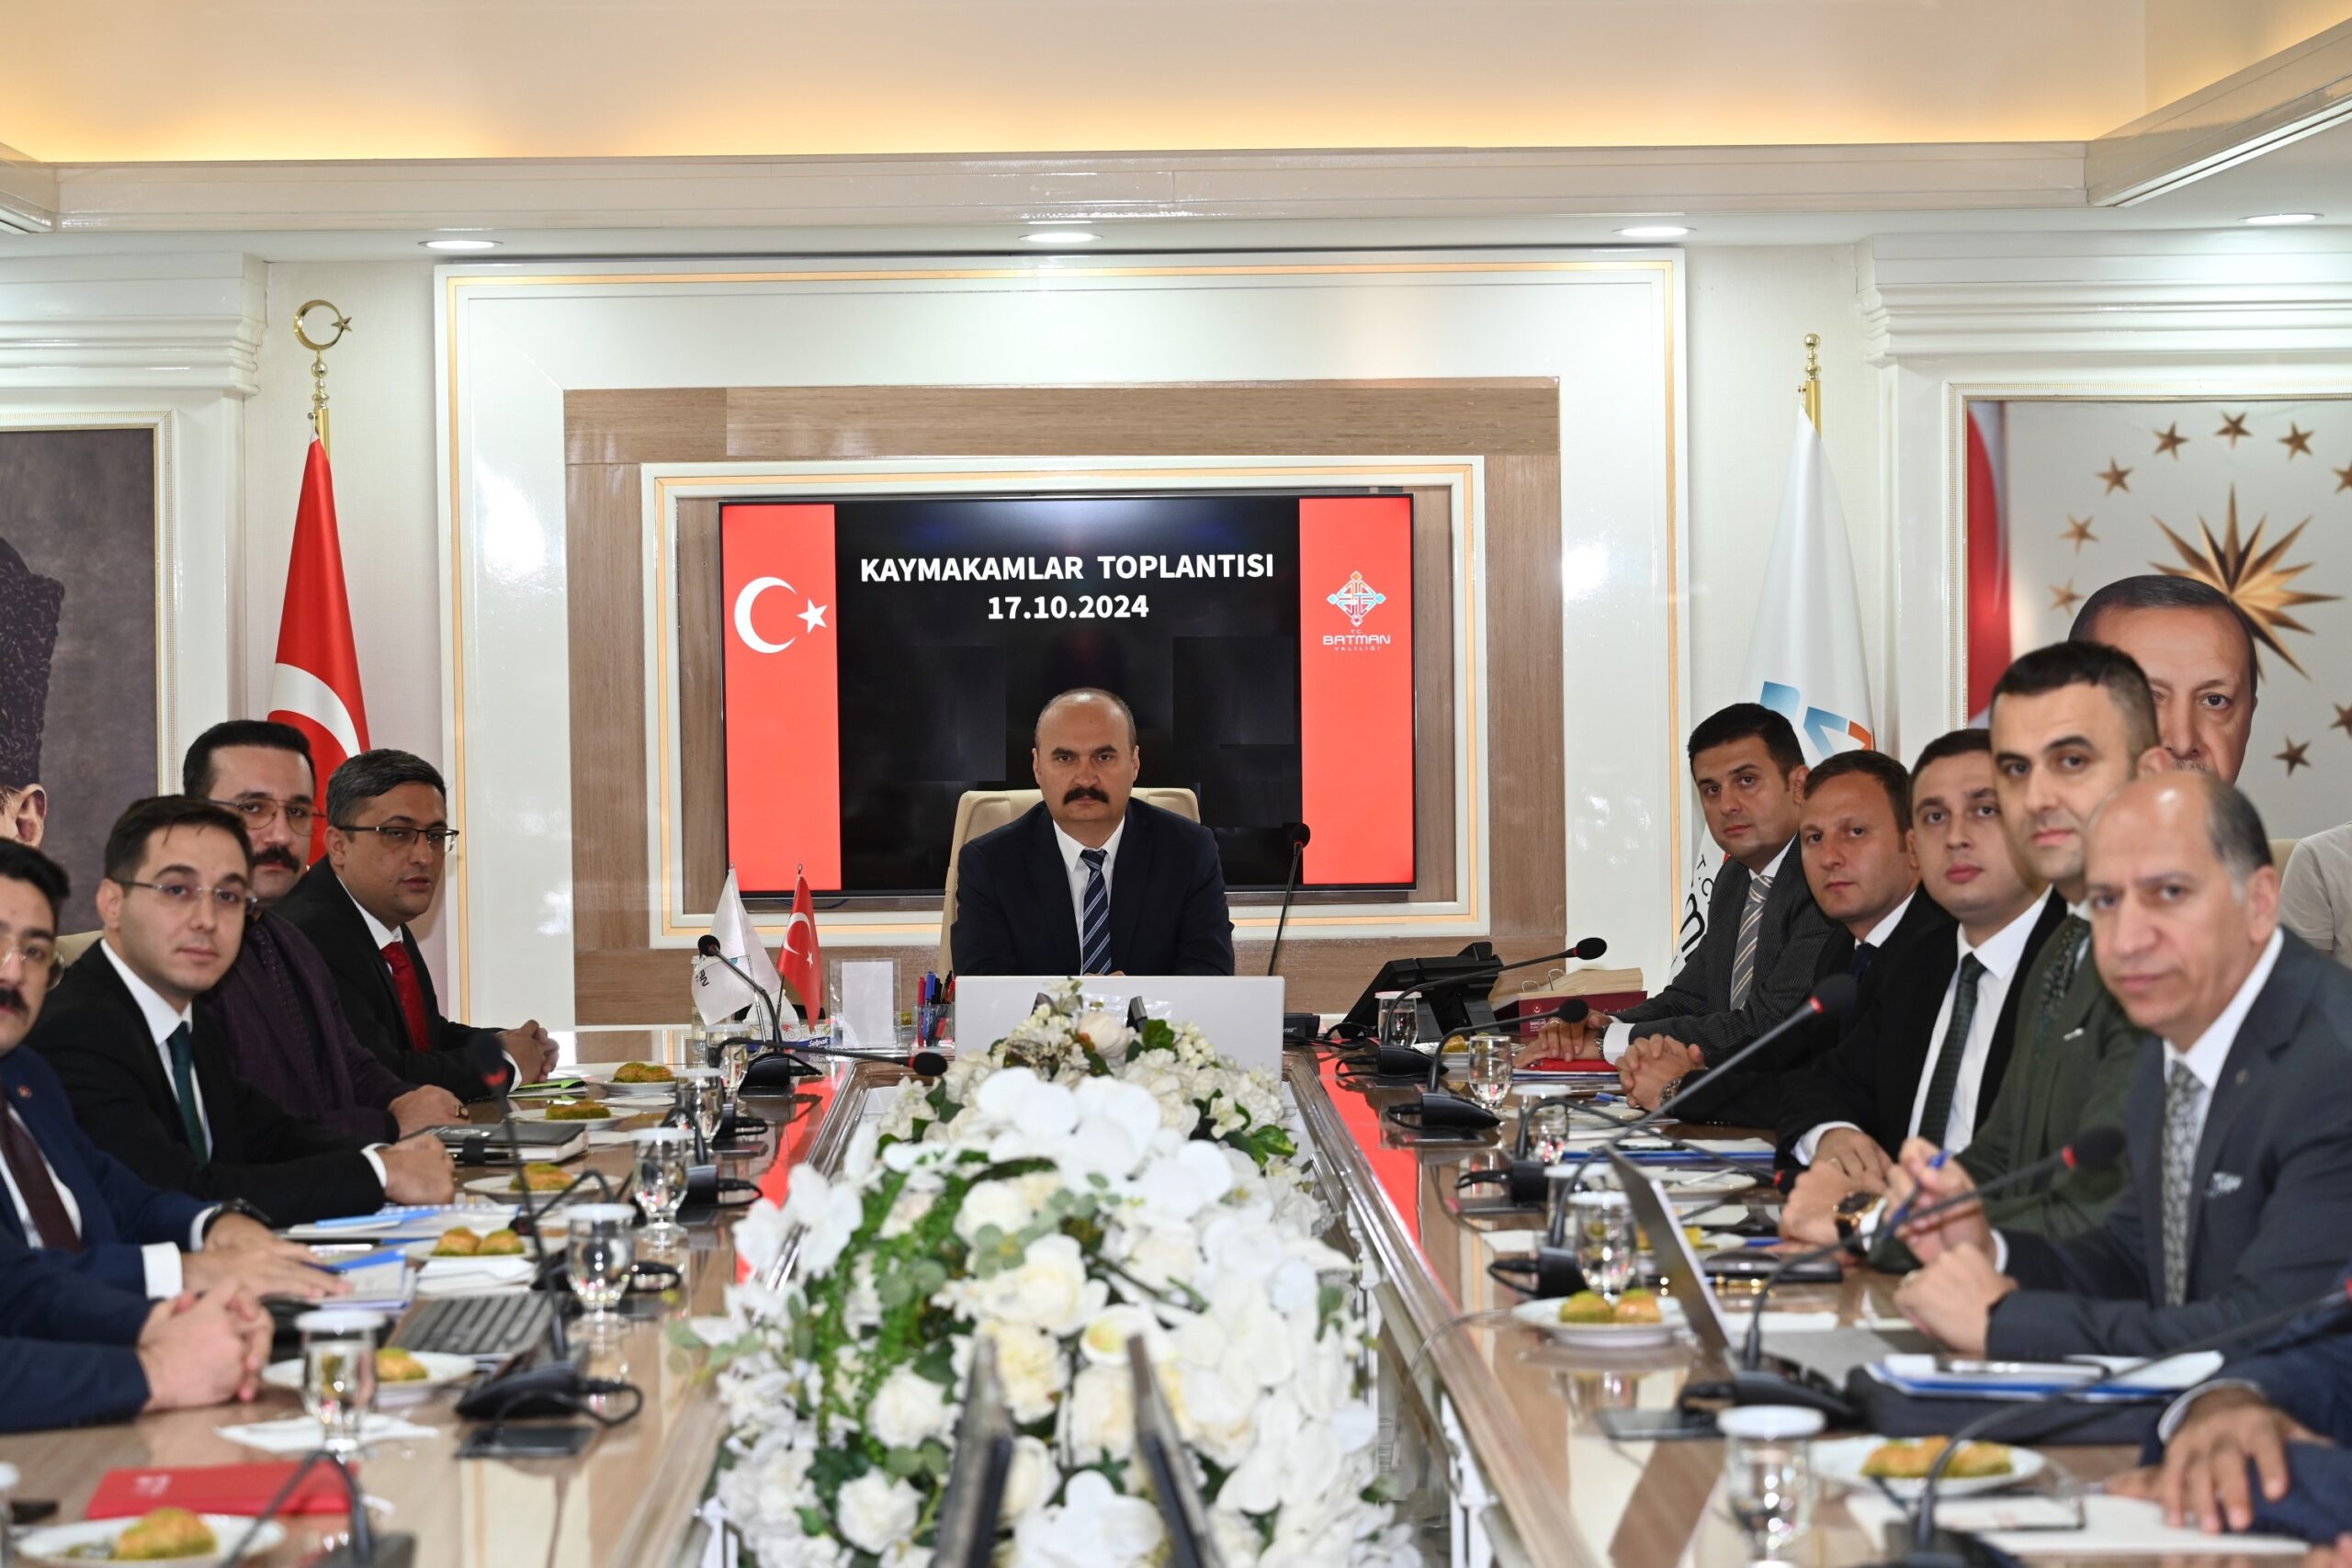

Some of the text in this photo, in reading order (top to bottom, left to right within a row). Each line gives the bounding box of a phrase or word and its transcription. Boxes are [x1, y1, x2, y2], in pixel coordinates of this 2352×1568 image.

[862, 554, 1272, 582] KAYMAKAMLAR TOPLANTISI
[988, 594, 1148, 620] 17.10.2024
[1323, 635, 1390, 646] BATMAN
[808, 1038, 829, 1047] Selpak
